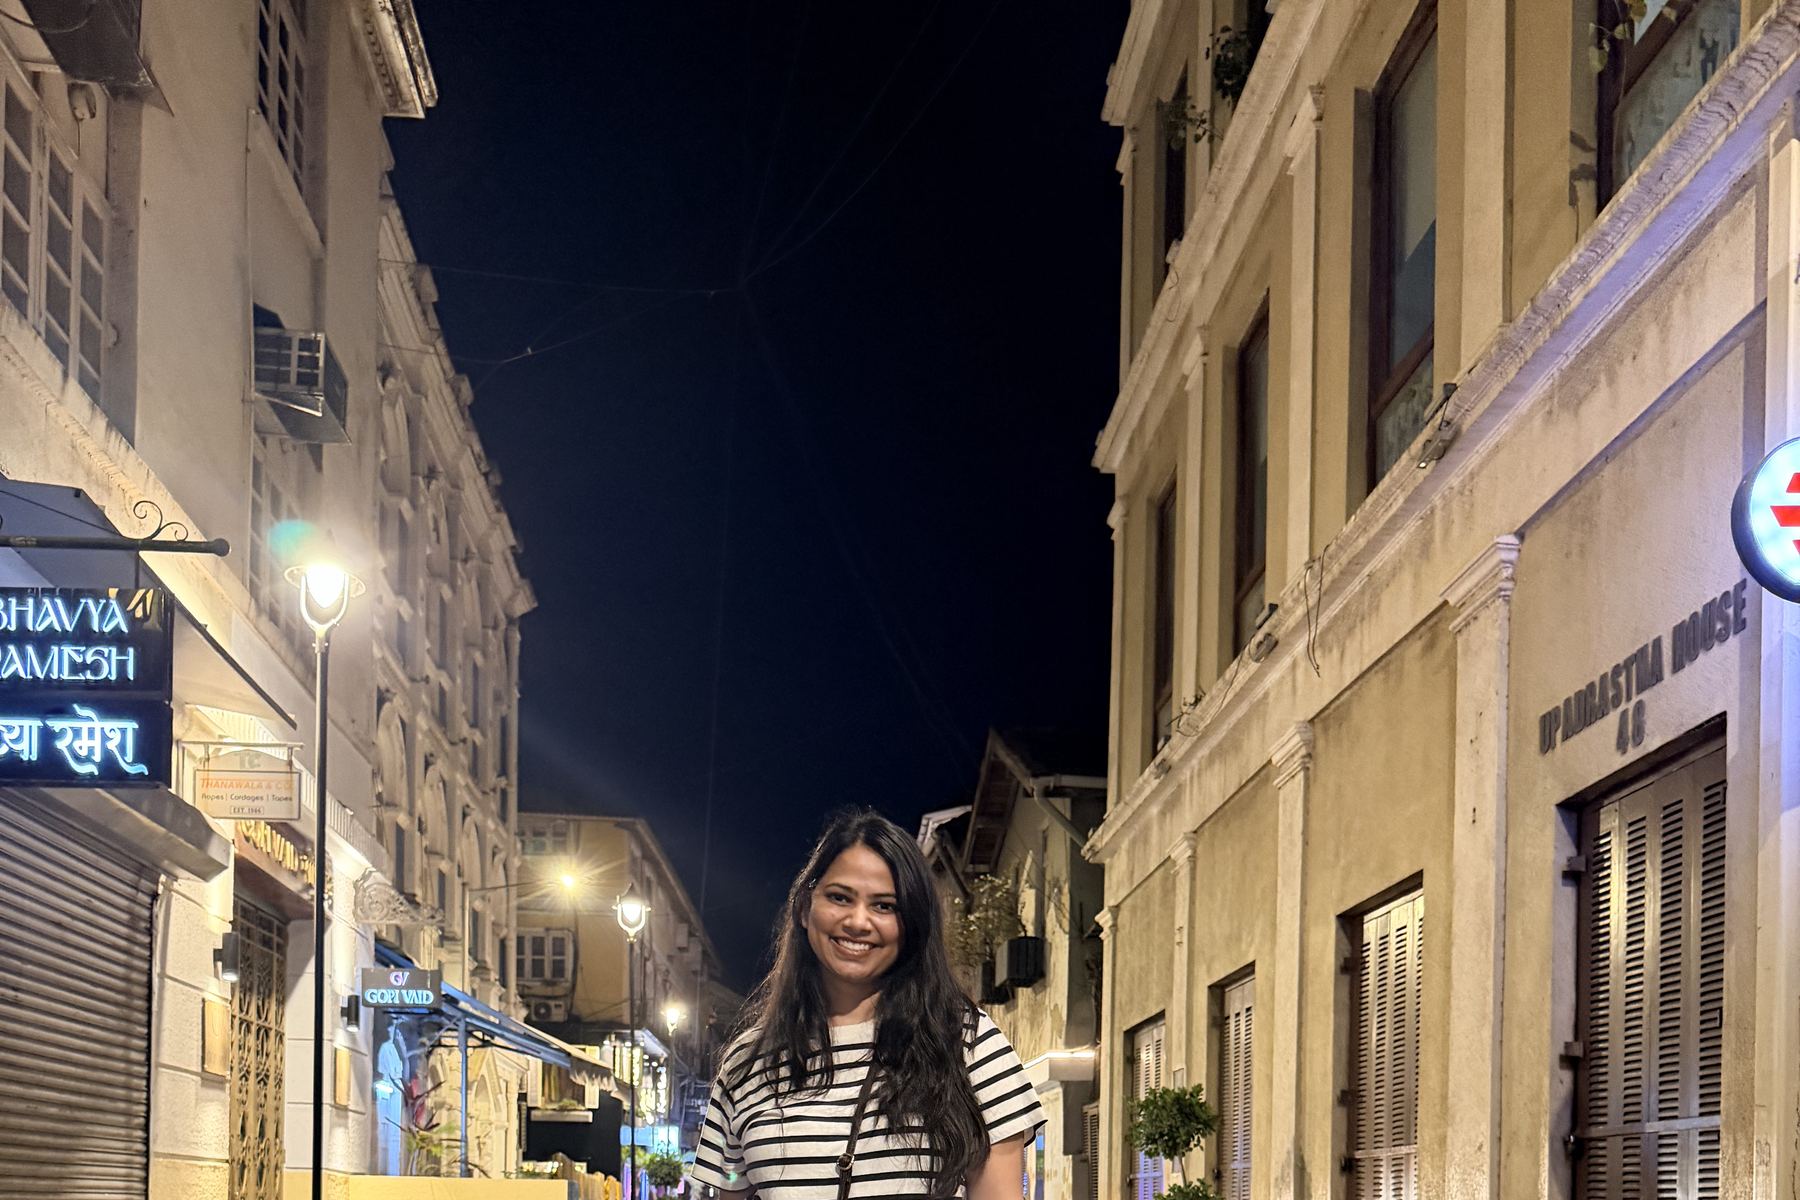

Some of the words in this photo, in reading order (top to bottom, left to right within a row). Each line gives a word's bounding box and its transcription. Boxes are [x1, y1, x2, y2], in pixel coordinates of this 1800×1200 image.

[0, 644, 134, 681] AMESH
[1539, 635, 1664, 756] UPADRASTHA
[1672, 578, 1748, 675] HOUSE
[1616, 699, 1646, 755] 48
[364, 988, 400, 1004] GOPI
[401, 989, 434, 1005] VAID
